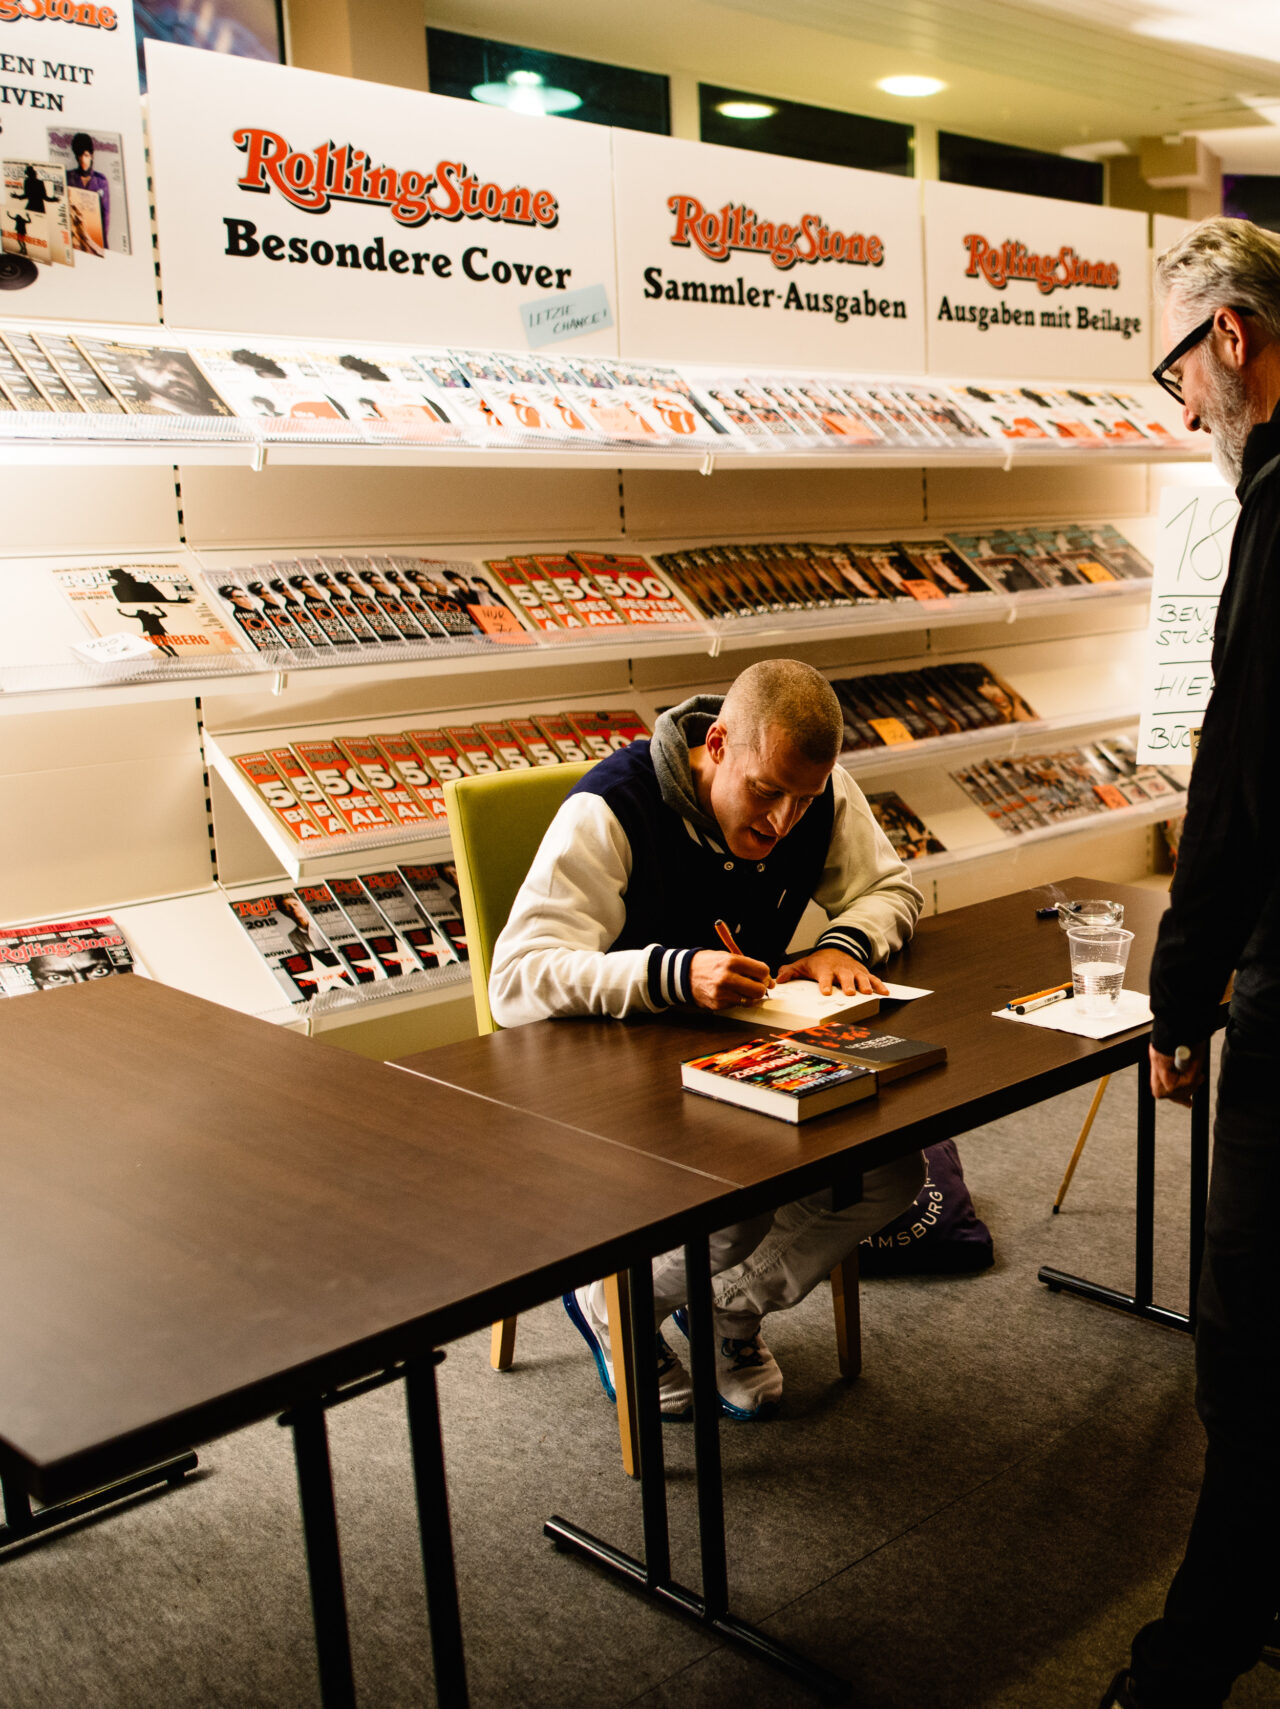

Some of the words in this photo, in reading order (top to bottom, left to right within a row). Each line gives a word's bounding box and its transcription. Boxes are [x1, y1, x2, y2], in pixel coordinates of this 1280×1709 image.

[42, 60, 94, 85] MIT
[223, 217, 452, 278] Besondere
[462, 246, 571, 289] Cover
[643, 266, 908, 323] Sammler-Ausgaben
[938, 296, 1035, 331] Ausgaben
[1041, 305, 1072, 328] mit
[1077, 306, 1142, 339] Beilage
[594, 574, 674, 599] 500
[244, 917, 279, 931] 2015
[263, 948, 293, 959] BOWIE
